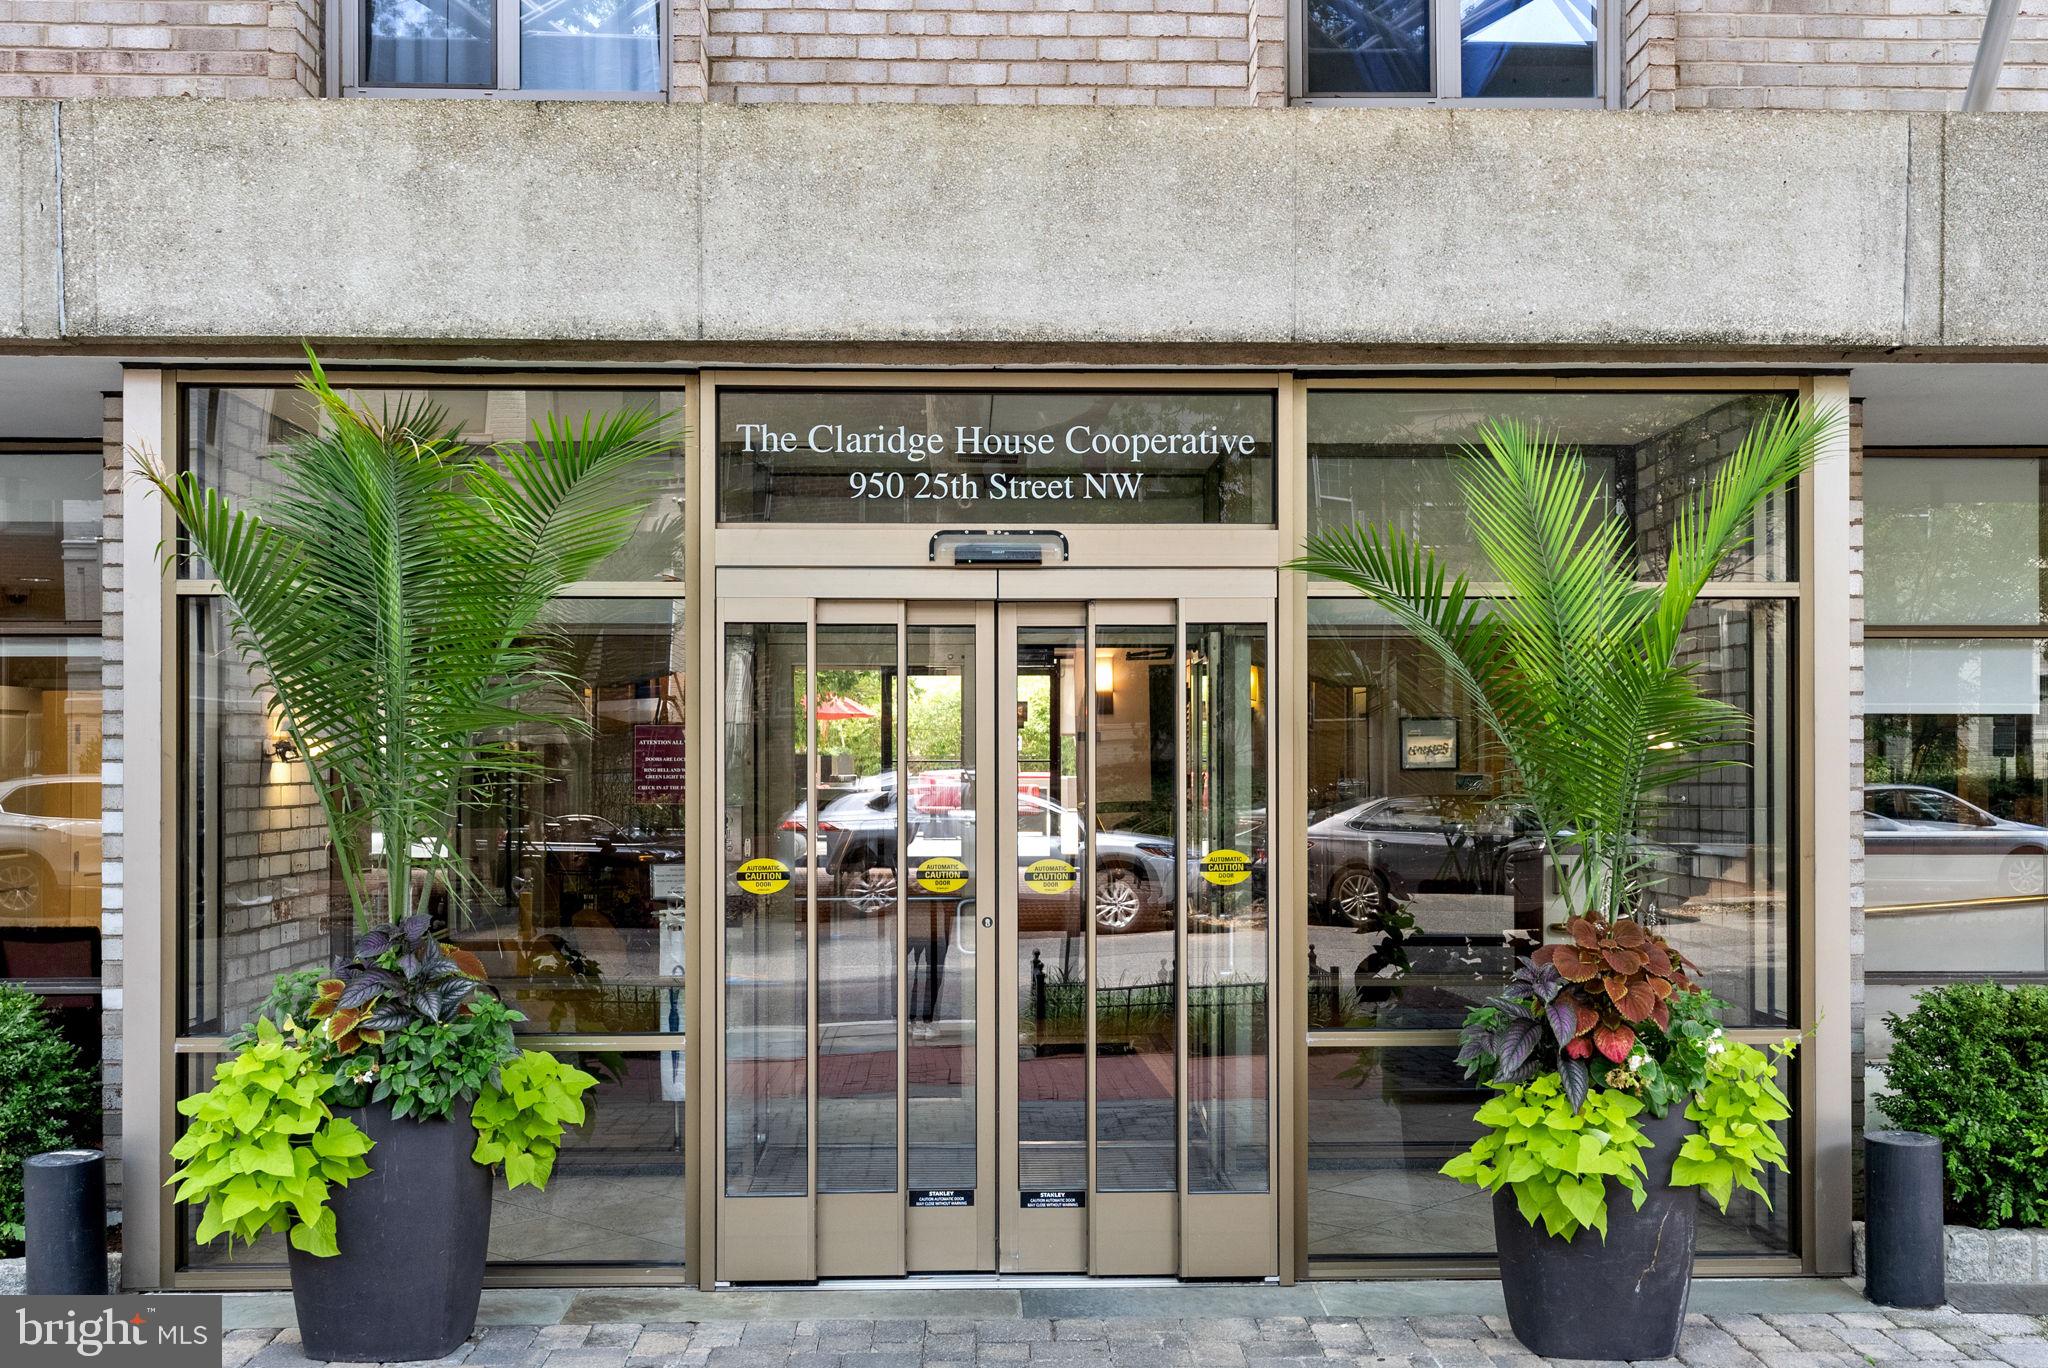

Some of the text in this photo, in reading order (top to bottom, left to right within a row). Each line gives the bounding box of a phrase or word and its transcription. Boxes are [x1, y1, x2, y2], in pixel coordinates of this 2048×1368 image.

[735, 423, 1256, 463] The Claridge House Cooperative
[849, 471, 1145, 500] 950 25th Street NW
[1208, 864, 1244, 872] CAUTION
